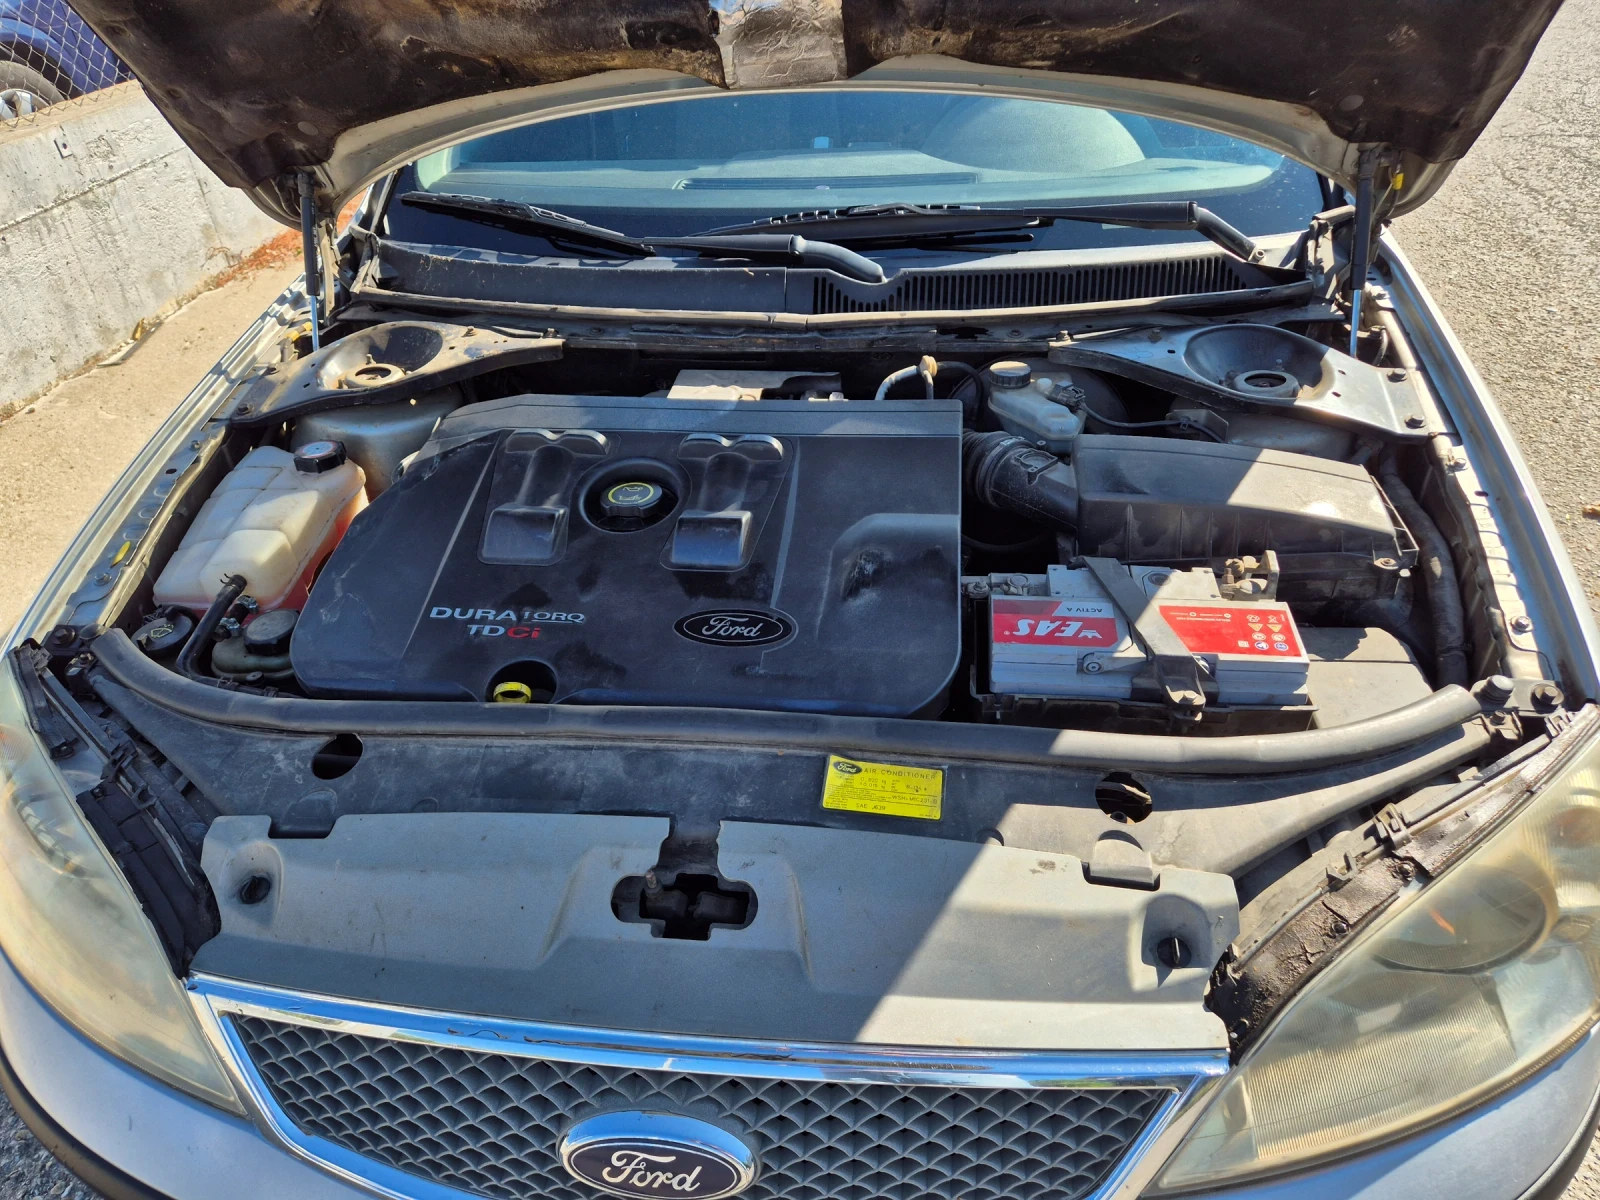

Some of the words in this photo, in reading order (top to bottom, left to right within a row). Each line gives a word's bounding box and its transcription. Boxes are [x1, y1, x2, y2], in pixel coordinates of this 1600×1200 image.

[467, 624, 541, 639] TDCi
[702, 616, 764, 637] Ford
[1012, 619, 1084, 636] EAS
[837, 762, 857, 773] Ford
[881, 769, 936, 780] CONDITIONER
[602, 1150, 702, 1192] Ford
